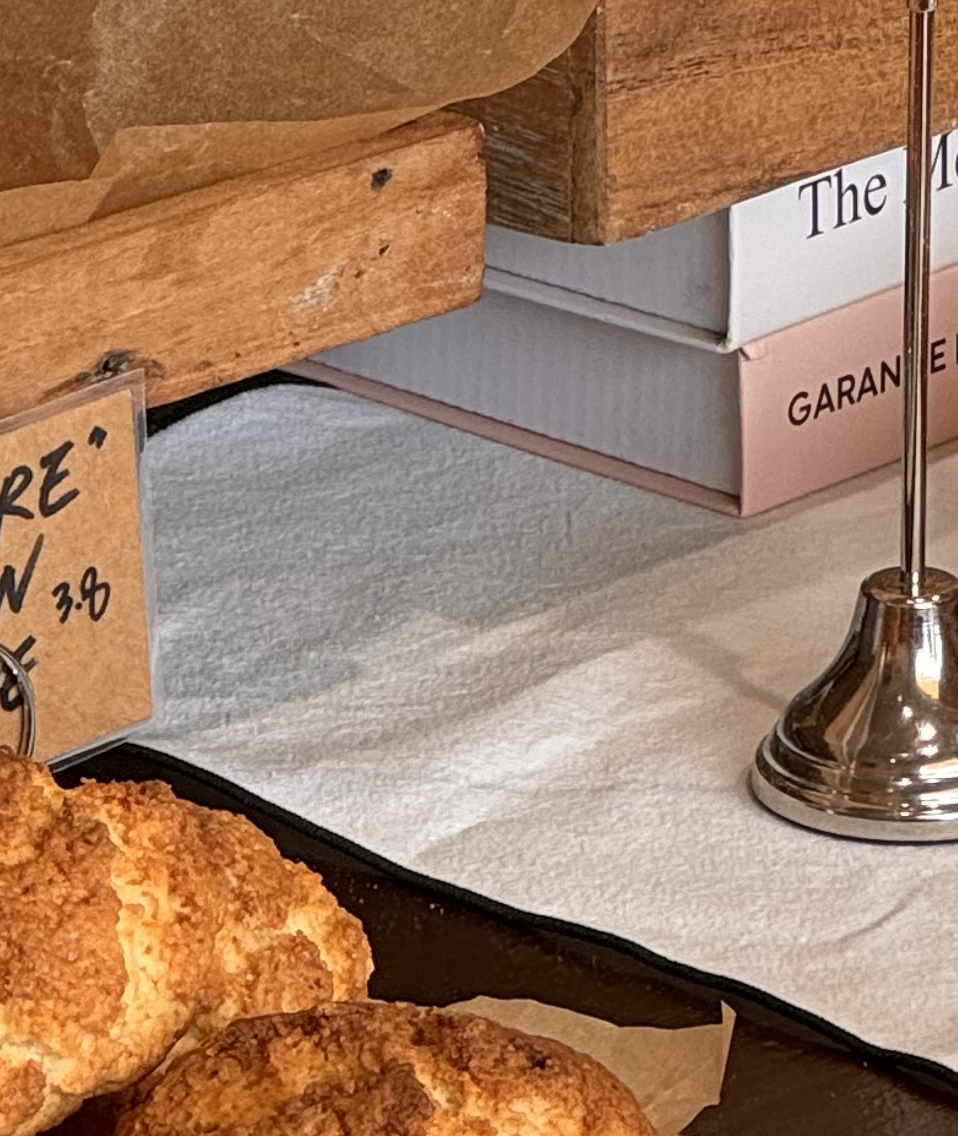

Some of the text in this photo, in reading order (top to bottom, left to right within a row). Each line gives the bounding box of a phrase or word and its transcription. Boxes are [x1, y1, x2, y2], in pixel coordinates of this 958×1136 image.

[797, 168, 888, 240] The
[787, 337, 947, 426] GARANE
[51, 566, 111, 625] 3.8
